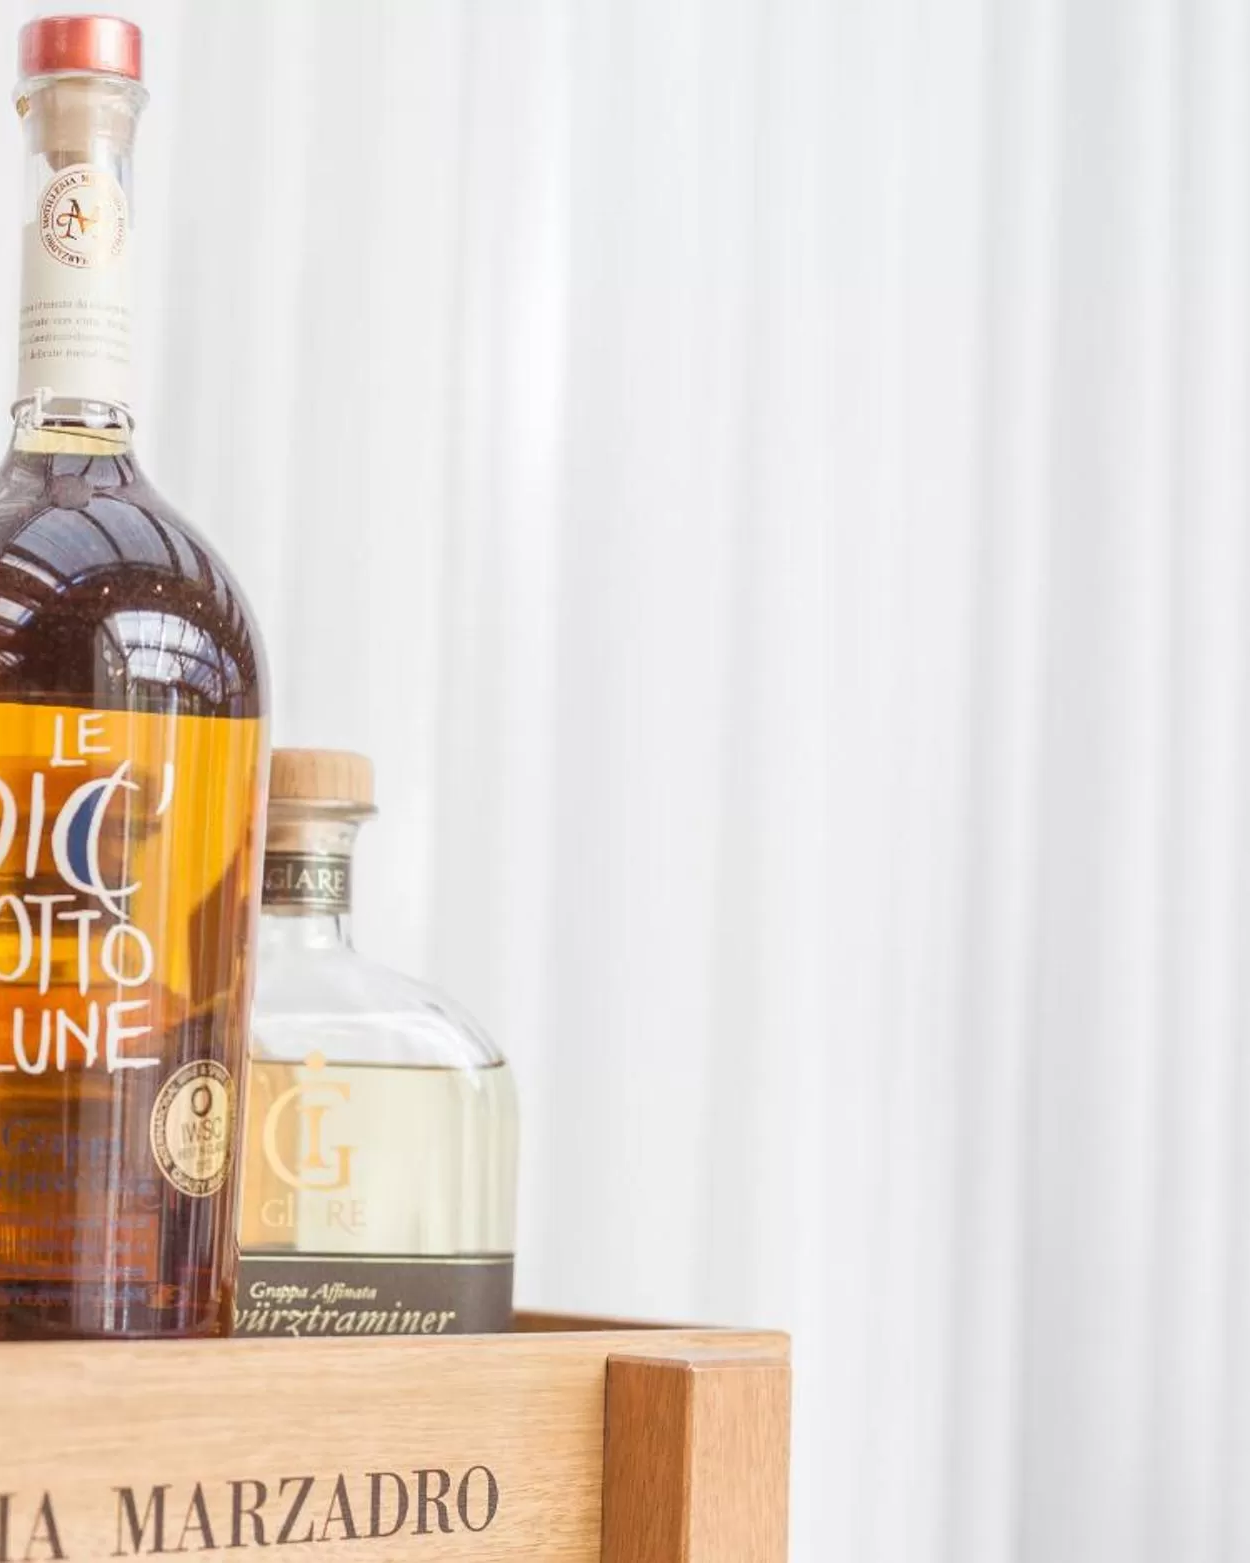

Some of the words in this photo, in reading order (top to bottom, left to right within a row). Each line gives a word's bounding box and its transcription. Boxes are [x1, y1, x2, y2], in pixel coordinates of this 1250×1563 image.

[50, 713, 111, 767] LE
[268, 863, 346, 898] GIARE
[260, 1191, 368, 1237] GIRE
[249, 1281, 309, 1303] Grappa
[310, 1282, 378, 1304] Affinata
[112, 1465, 499, 1557] MARZADRO
